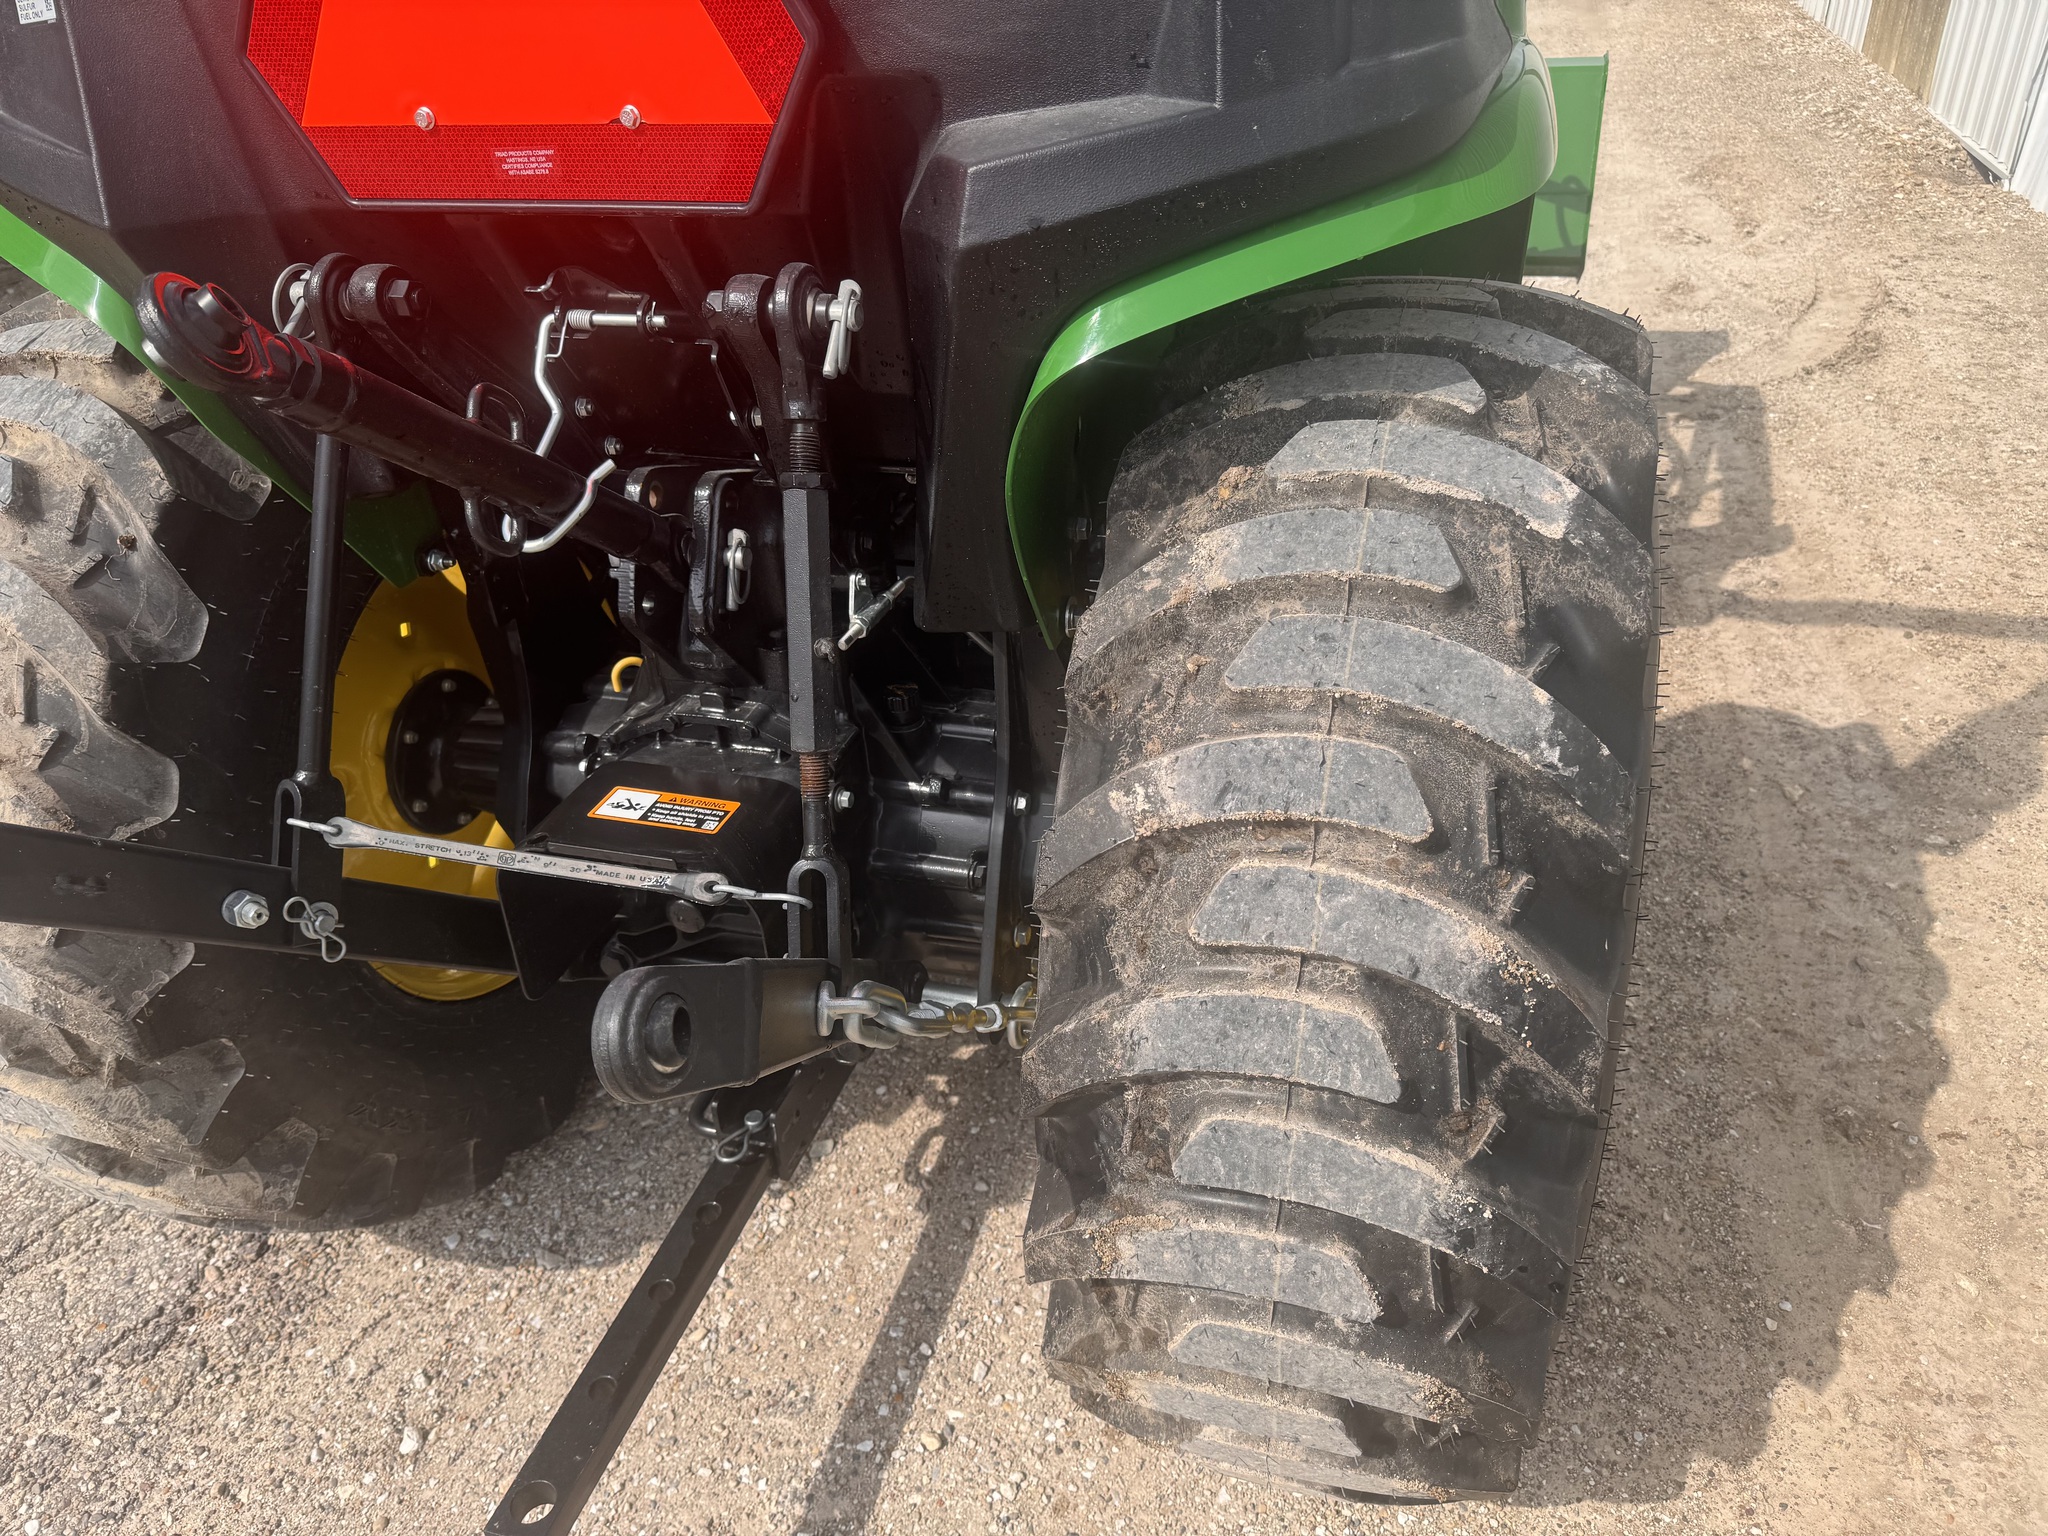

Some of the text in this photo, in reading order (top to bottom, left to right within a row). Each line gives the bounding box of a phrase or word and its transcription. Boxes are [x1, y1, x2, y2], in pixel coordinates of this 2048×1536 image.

[19, 3, 36, 12] SULFUR
[32, 10, 43, 19] ONLY
[680, 798, 726, 809] WARNING
[659, 818, 682, 826] clothing
[414, 842, 452, 853] STRETCH
[595, 870, 621, 879] MADE
